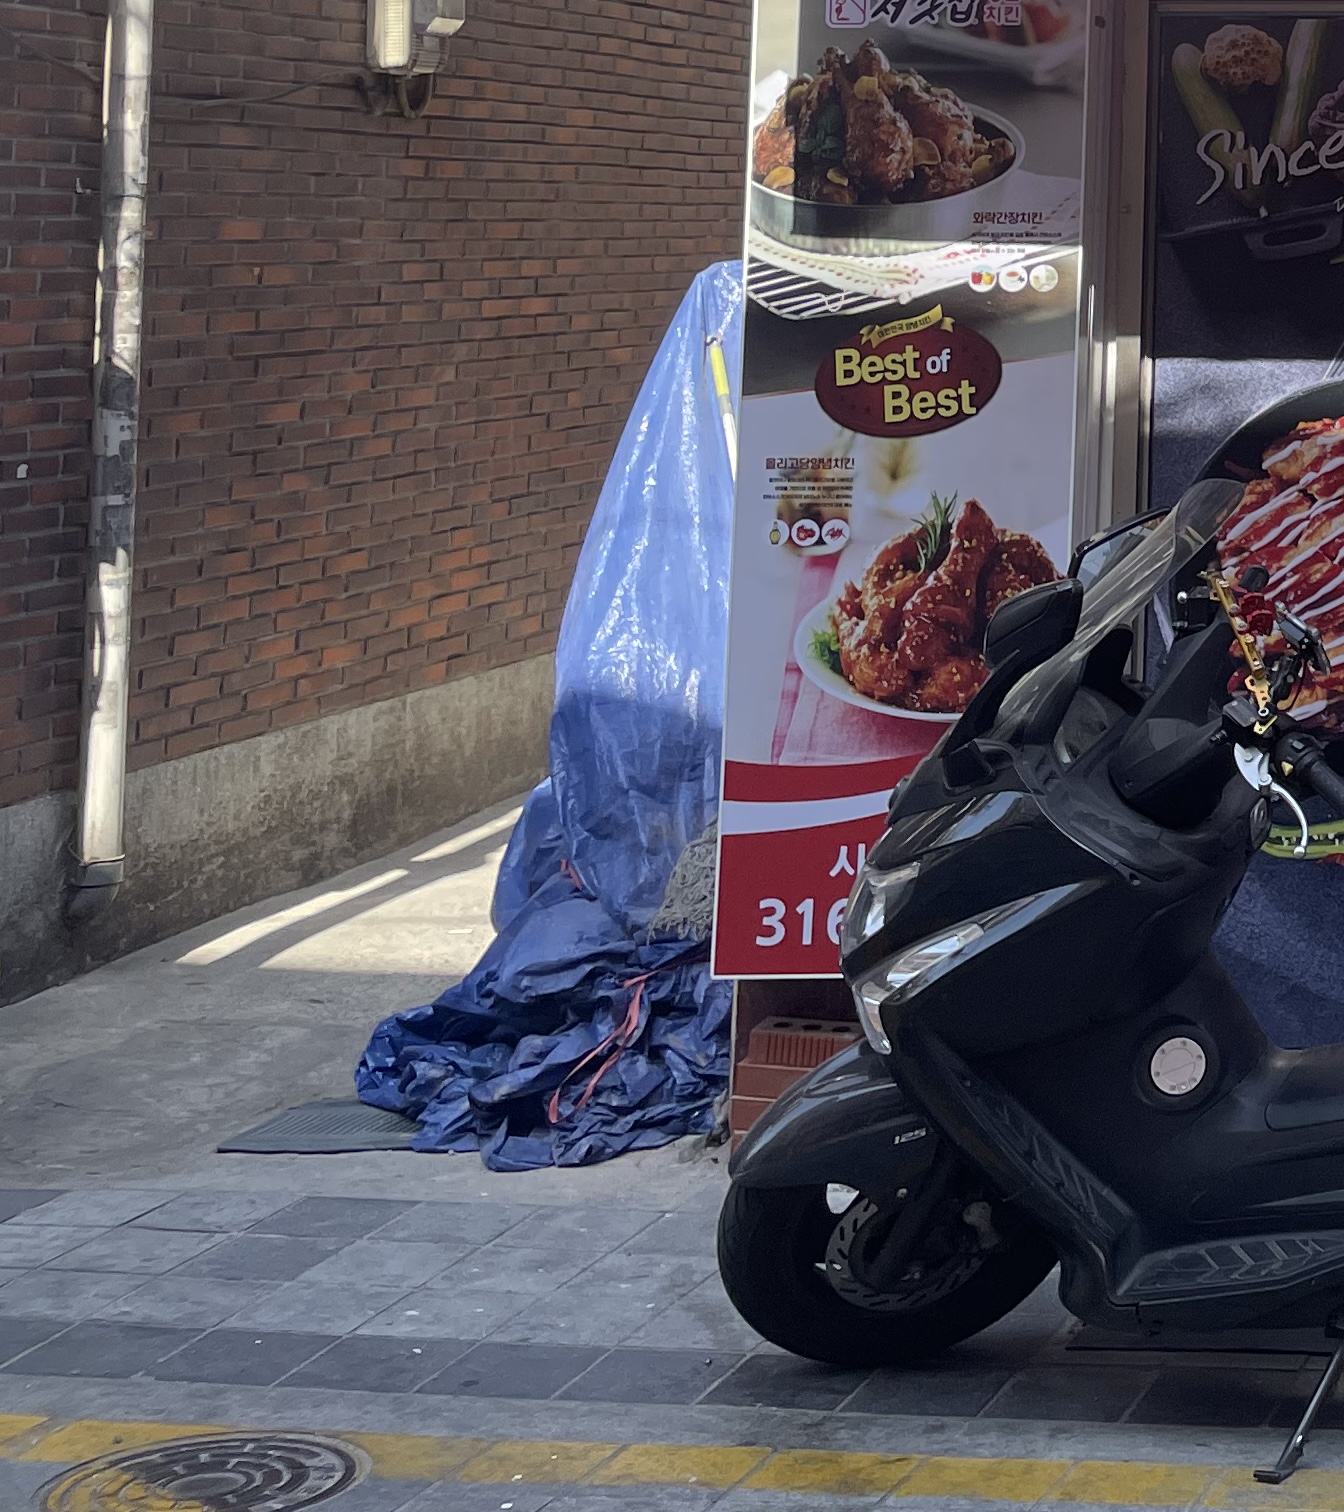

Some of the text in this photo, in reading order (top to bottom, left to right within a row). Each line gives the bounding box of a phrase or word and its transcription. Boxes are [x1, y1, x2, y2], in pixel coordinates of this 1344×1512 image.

[985, 5, 1020, 24] 치킨
[834, 345, 951, 387] Best of
[884, 379, 977, 423] Best
